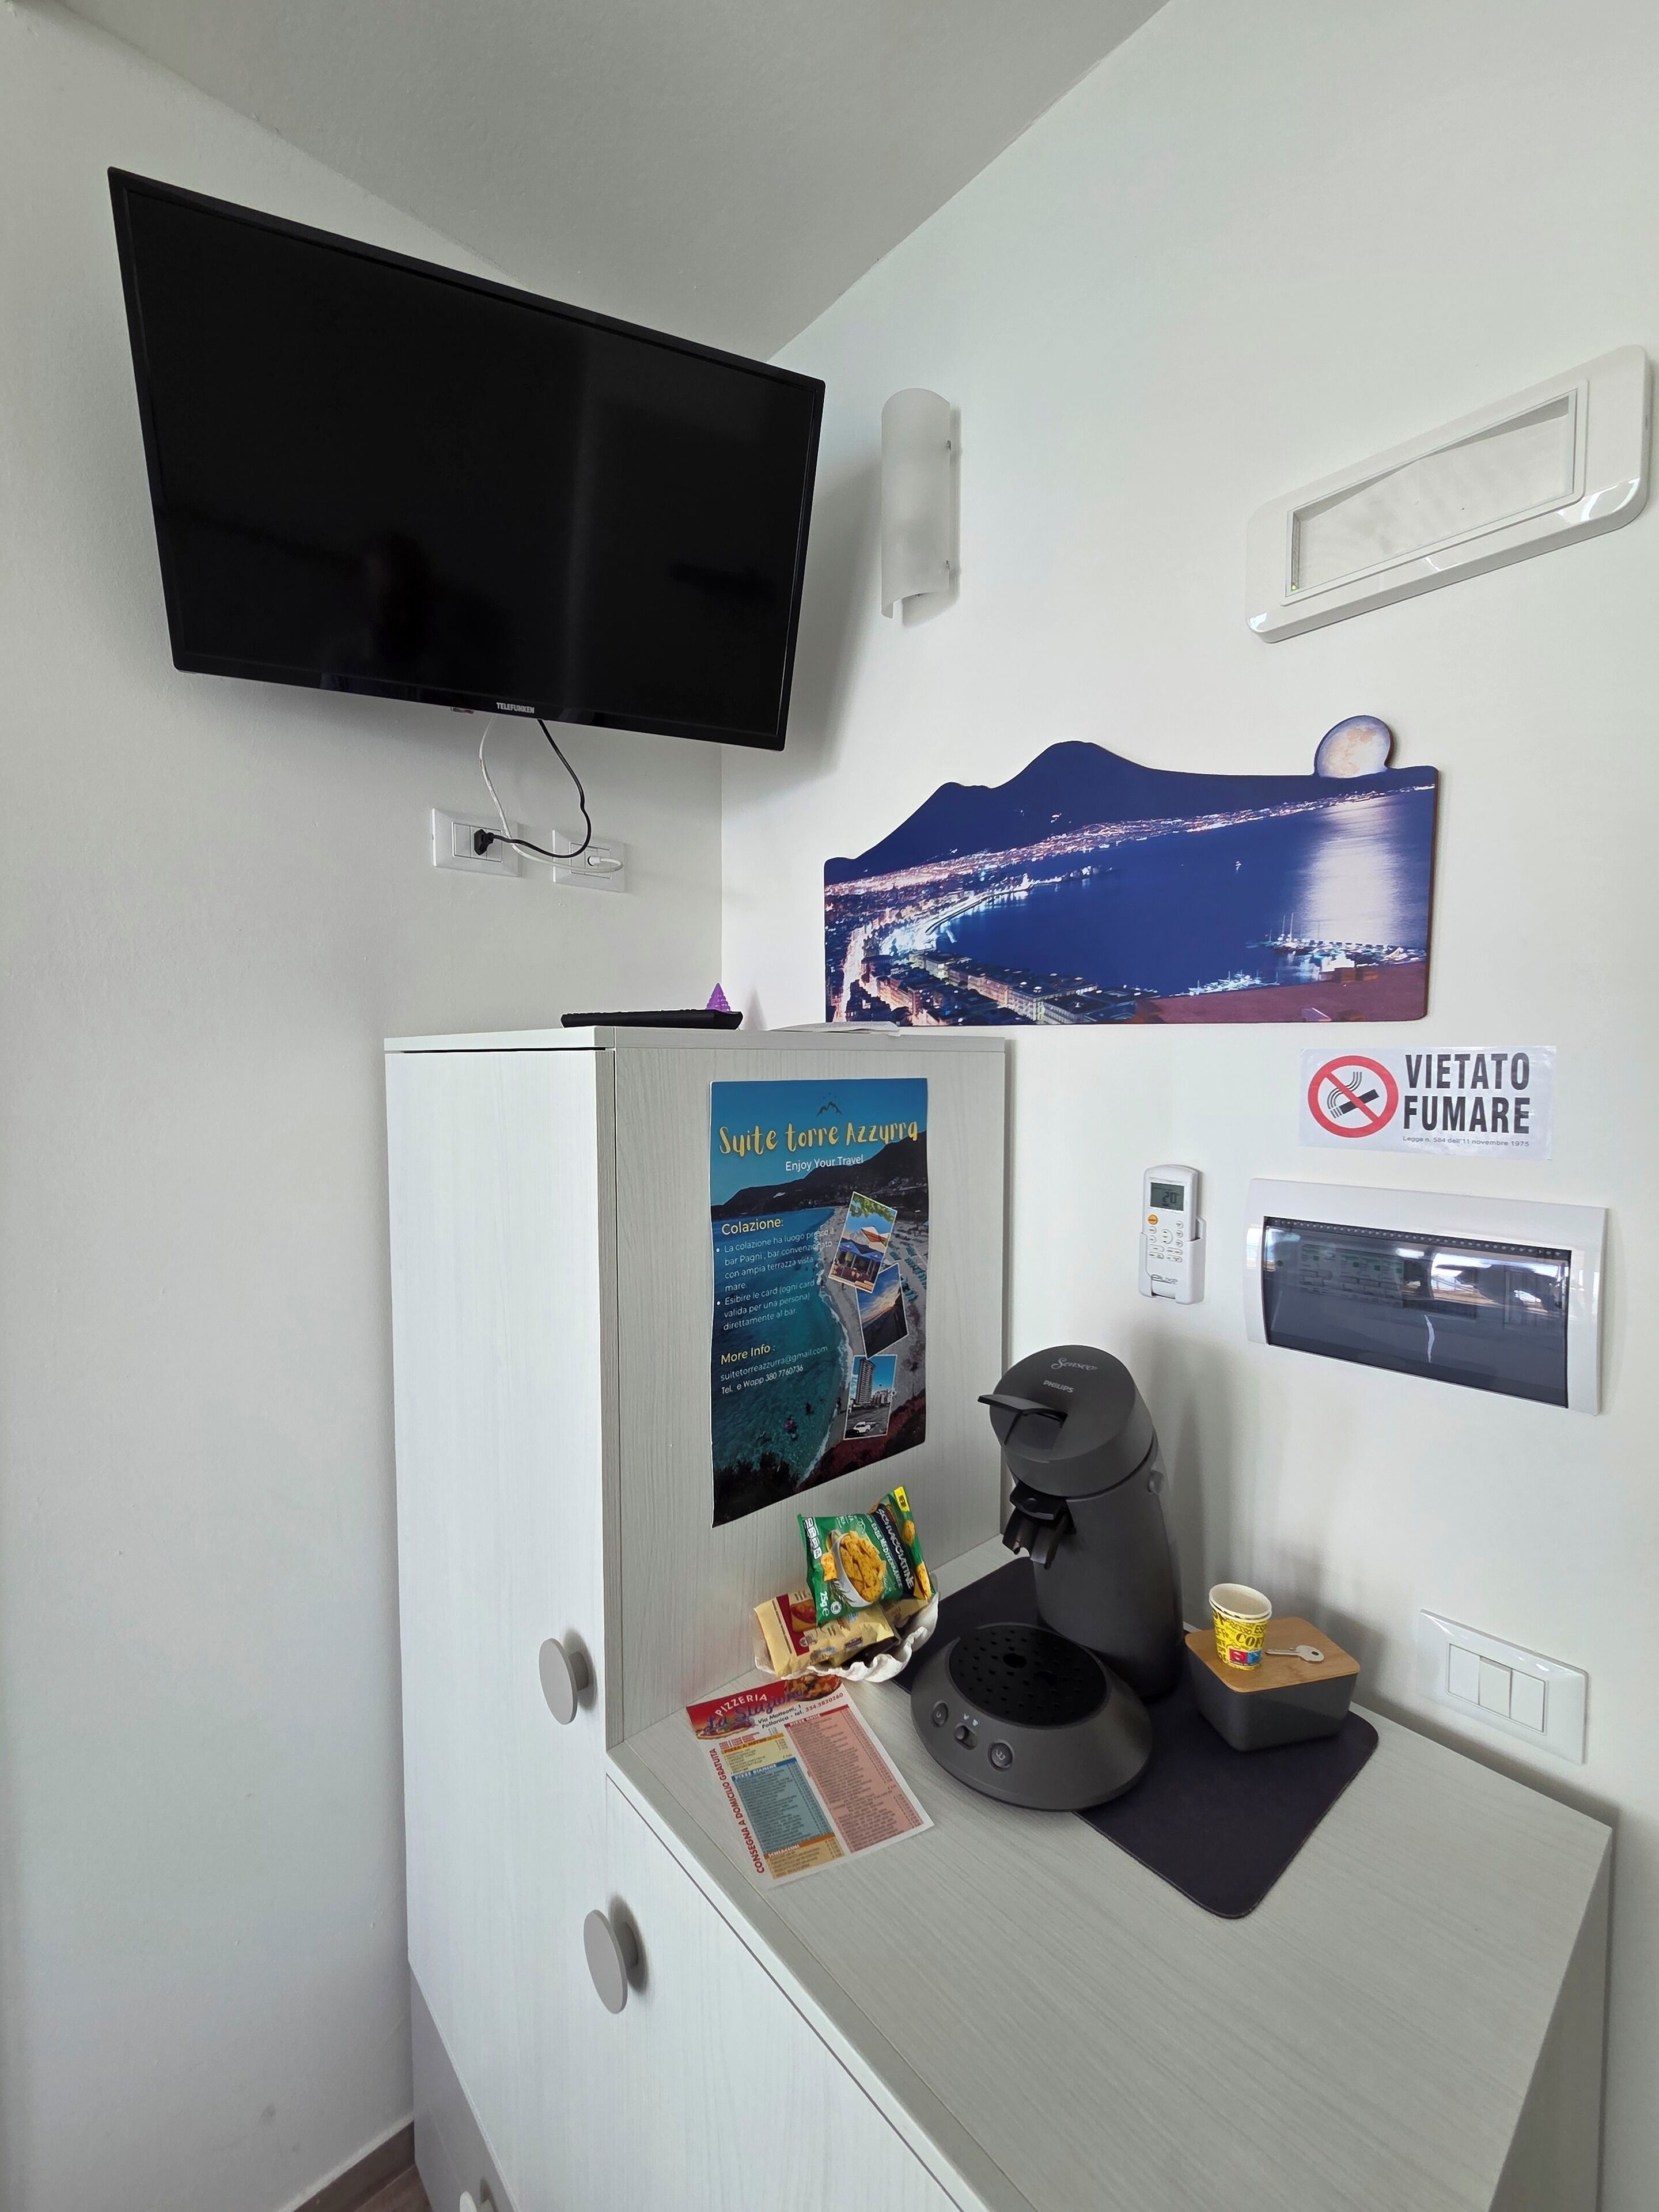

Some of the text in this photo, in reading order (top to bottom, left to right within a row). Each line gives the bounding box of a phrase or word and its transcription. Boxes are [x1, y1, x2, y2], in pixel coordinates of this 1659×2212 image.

[496, 702, 535, 714] TELEFUNKEN
[1405, 1052, 1530, 1090] VIETATO
[1403, 1095, 1531, 1134] FUMARE
[719, 1121, 918, 1157] Suite torre Azzurra
[785, 1154, 864, 1172] Enjoy Your Travel
[721, 1218, 784, 1236] Colazione:
[724, 1245, 733, 1253] La
[735, 1239, 772, 1250] colazione
[784, 1233, 805, 1243] luogo
[806, 1229, 829, 1240] presso
[830, 1227, 835, 1235] il
[725, 1258, 737, 1266] bar
[740, 1252, 763, 1263] Pagni
[767, 1250, 779, 1258] bar
[781, 1241, 833, 1256] convenzionato
[724, 1256, 814, 1279] con ampia terrazza vista
[724, 1279, 815, 1306] Esibire le card (ogni card
[725, 1282, 748, 1293] mare.
[724, 1292, 810, 1319] valida per una persona)
[723, 1308, 798, 1331] direttamente al bar.
[719, 1346, 829, 1382] suitetorreazzurra@gmail.com
[721, 1351, 748, 1365] More
[750, 1344, 771, 1357] Info
[721, 1385, 733, 1395] Tel.
[743, 1377, 765, 1388] Wapp
[765, 1372, 778, 1382] 380
[778, 1364, 804, 1377] 7760736
[1043, 1380, 1074, 1393] PHILIPS
[875, 1508, 915, 1589] SCHIACCIATINE
[715, 1694, 767, 1717] PIZZERIA
[769, 1707, 797, 1719] Matteotti,
[762, 1716, 789, 1729] Follonica
[794, 1709, 804, 1717] tel.
[709, 1748, 728, 1781] GRATUITA
[722, 1782, 744, 1819] DOMICILIO
[741, 1827, 765, 1874] CONSEGNA
